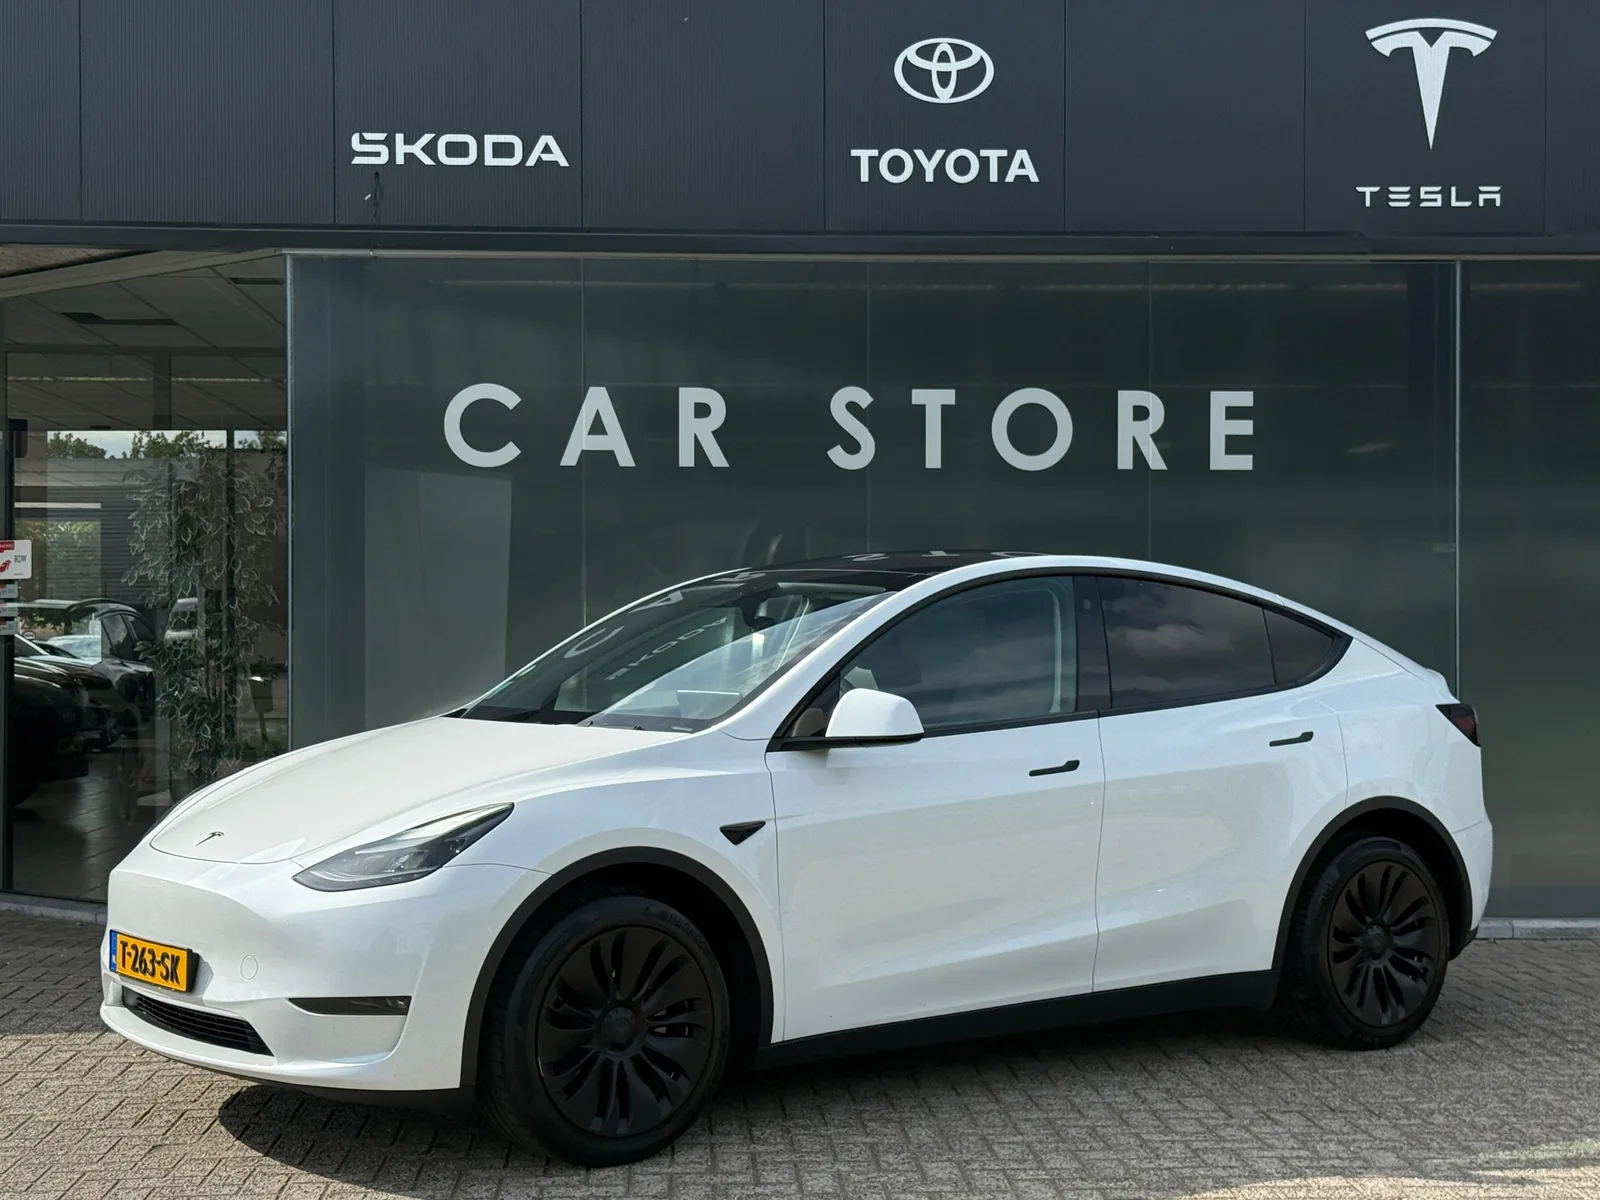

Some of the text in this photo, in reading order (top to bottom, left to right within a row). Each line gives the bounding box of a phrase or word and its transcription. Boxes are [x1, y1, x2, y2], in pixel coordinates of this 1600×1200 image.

[350, 132, 570, 168] SKODA
[850, 148, 1040, 184] TOYOTA
[1355, 185, 1503, 208] TESLA
[443, 382, 1254, 472] CAR STORE
[120, 940, 181, 986] T-263-SK
